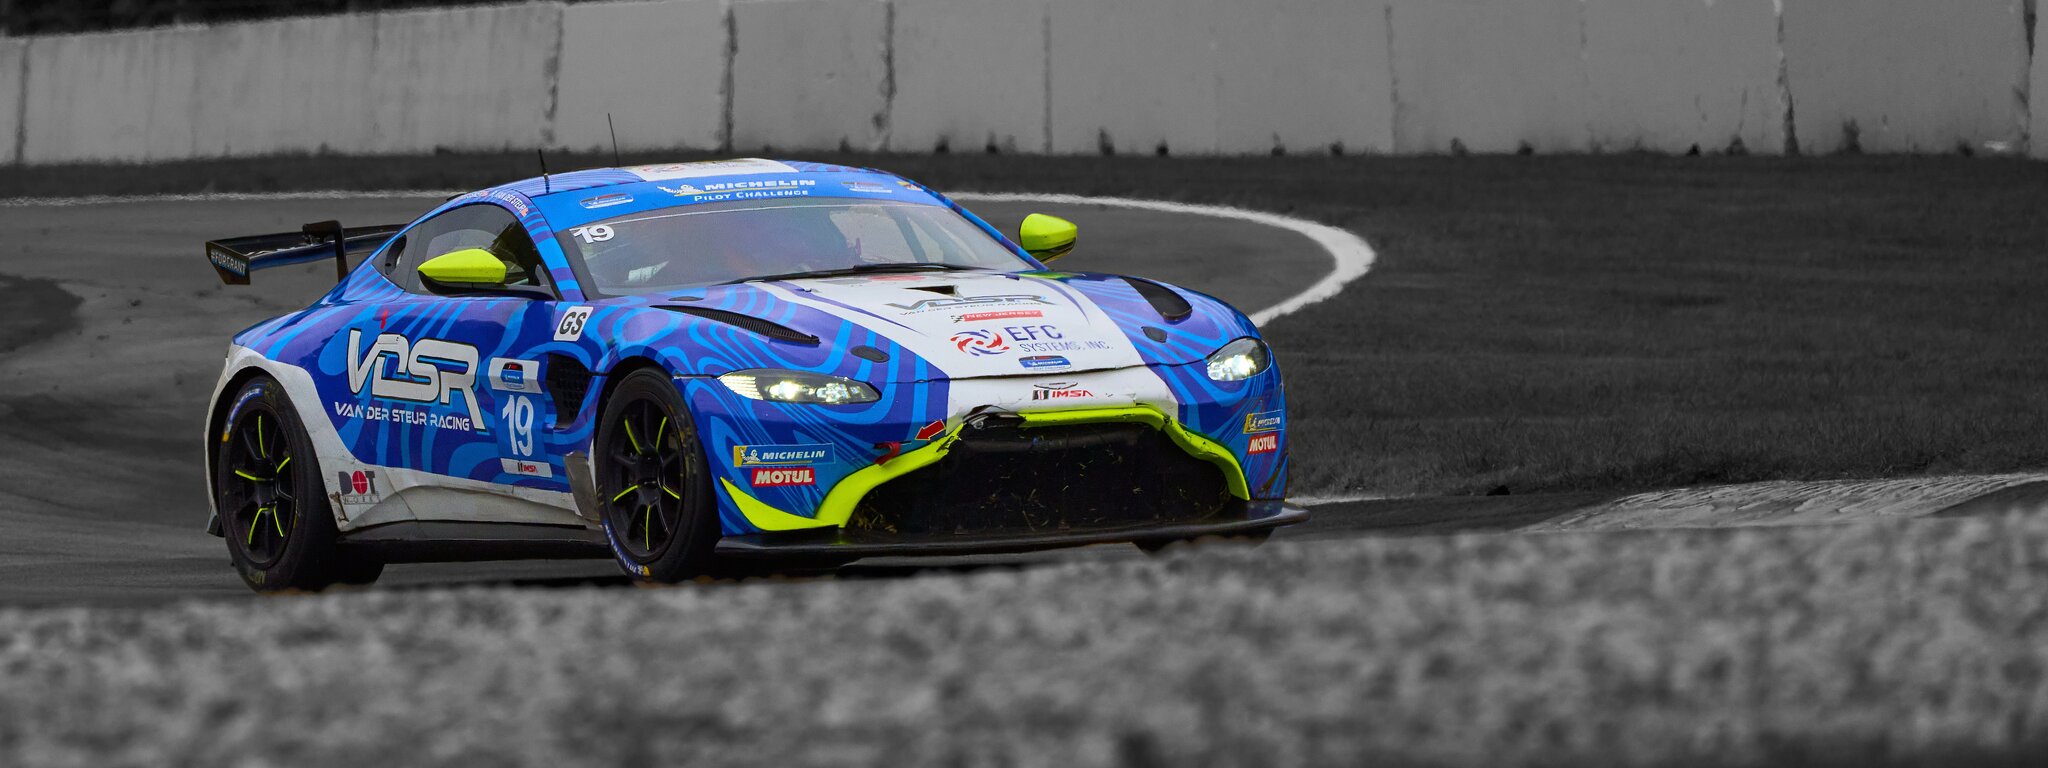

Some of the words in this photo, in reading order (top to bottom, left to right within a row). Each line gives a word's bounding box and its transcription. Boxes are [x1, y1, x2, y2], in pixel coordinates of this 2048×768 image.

[705, 179, 816, 191] MICHELIN
[570, 225, 615, 244] 19
[559, 312, 587, 335] GS
[1004, 325, 1062, 342] EFC
[1052, 390, 1094, 398] IMSA
[334, 401, 364, 419] VAN
[366, 406, 390, 420] DER
[392, 408, 427, 426] STEUR
[429, 413, 470, 432] RACING
[502, 395, 532, 457] 19
[1249, 436, 1276, 452] MOTUL
[762, 450, 825, 460] MICHELIN
[338, 470, 376, 496] DOT
[754, 470, 813, 484] MOTUL
